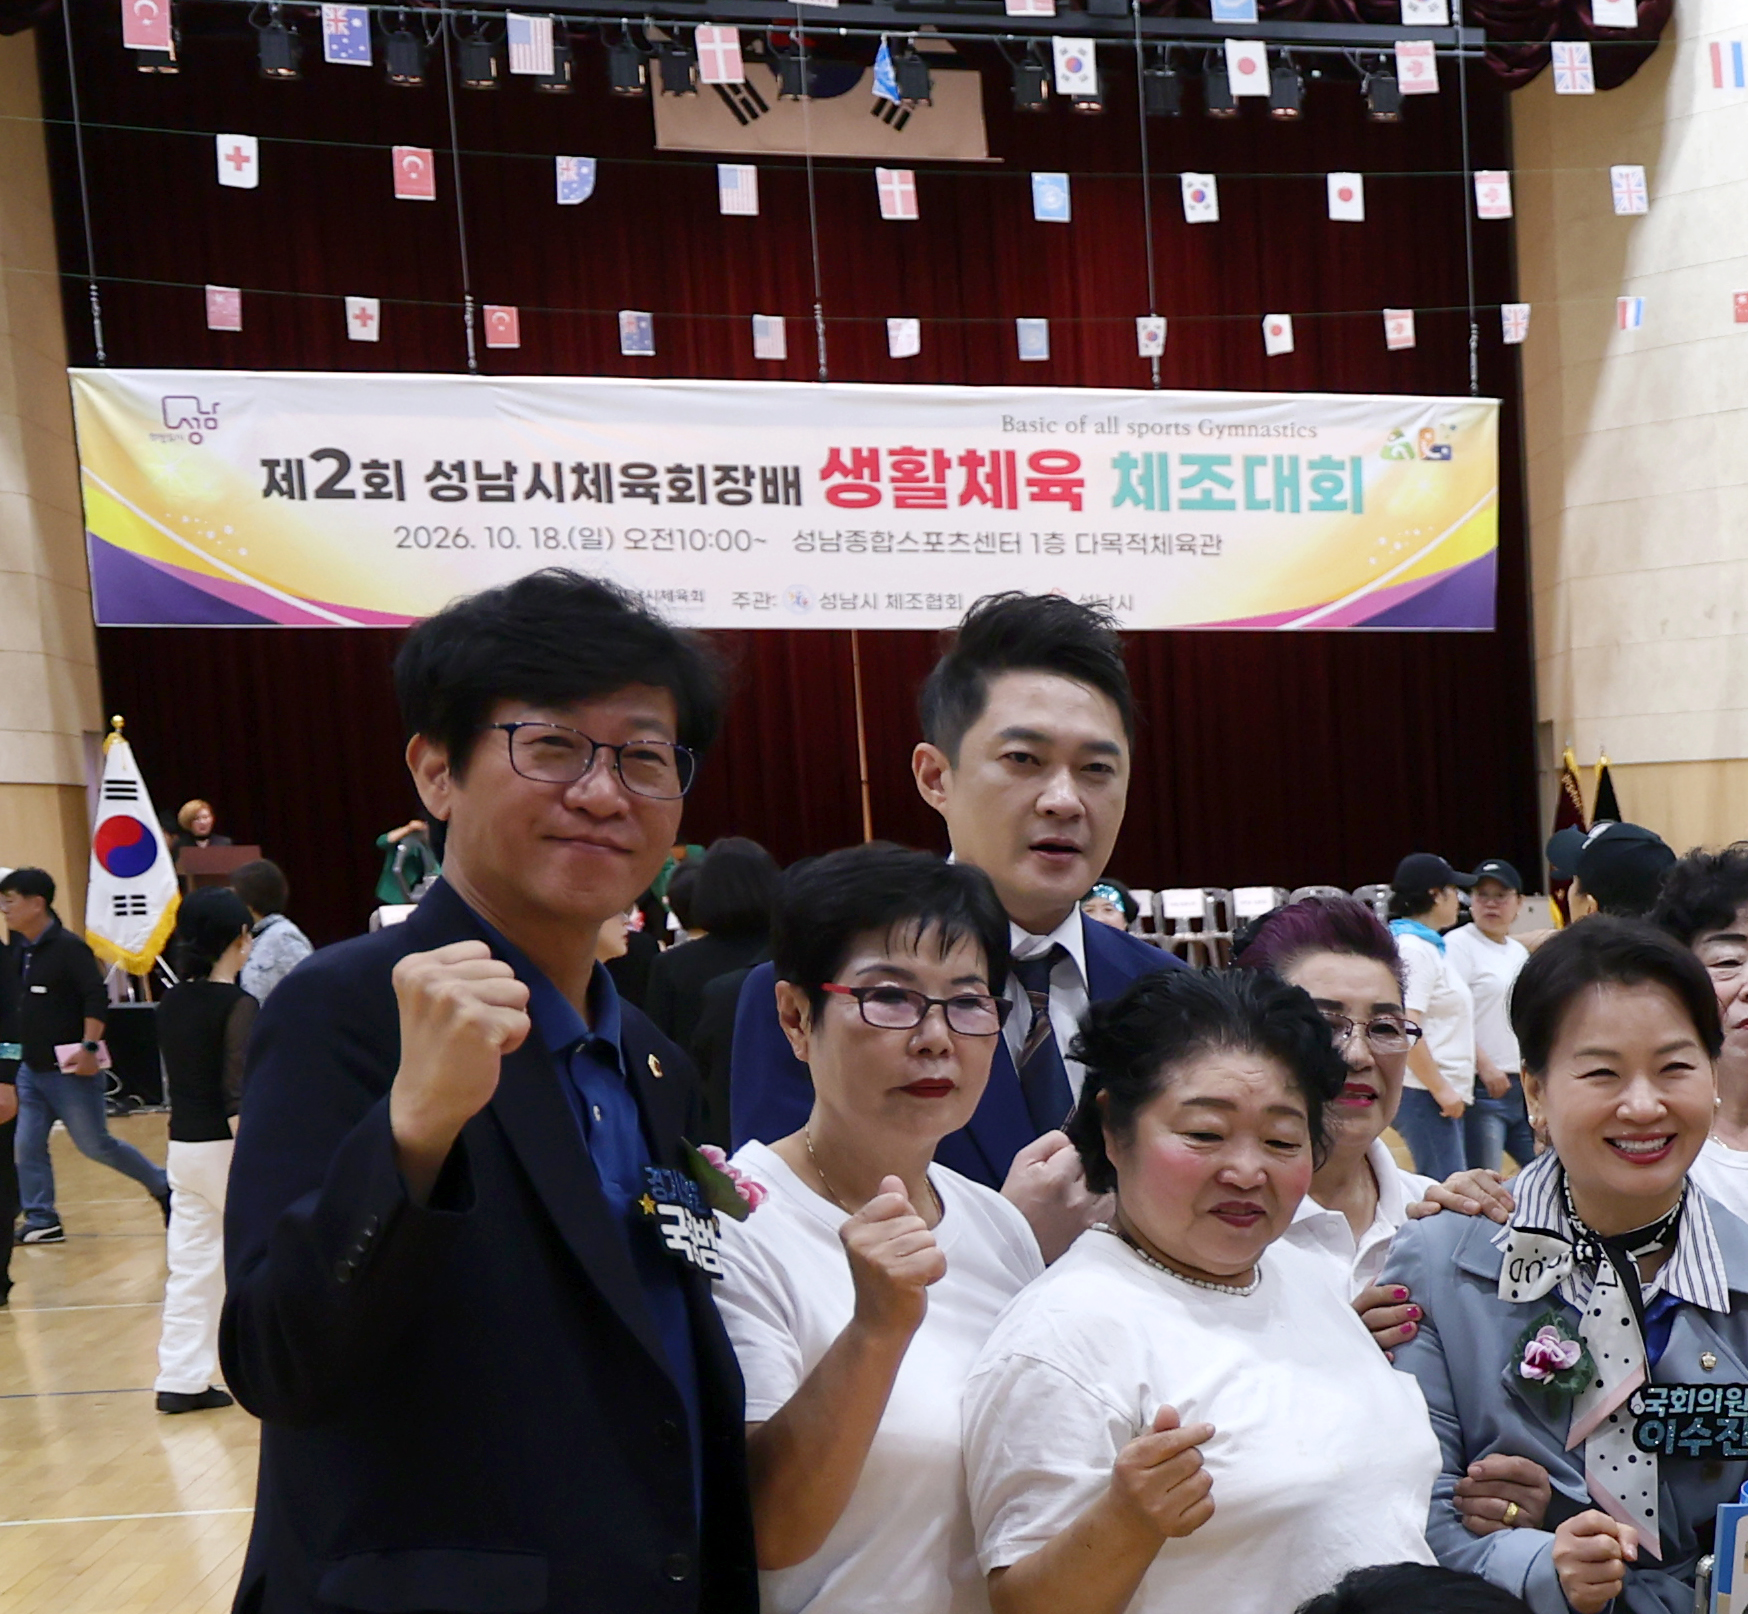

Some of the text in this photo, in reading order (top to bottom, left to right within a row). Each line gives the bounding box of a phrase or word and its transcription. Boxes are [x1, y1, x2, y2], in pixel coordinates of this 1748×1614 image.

[1001, 414, 1317, 442] Basic of all sports Gymnastics
[259, 445, 1364, 515] 제2회 성남시체육회장배 생활체육 체조대회
[393, 525, 1222, 557] 2026. 10. 18.(일) 오전10:00~ 성남종합스포츠센터 1층 다목적체육관
[732, 589, 963, 612] 주관: 성남시 체조협회
